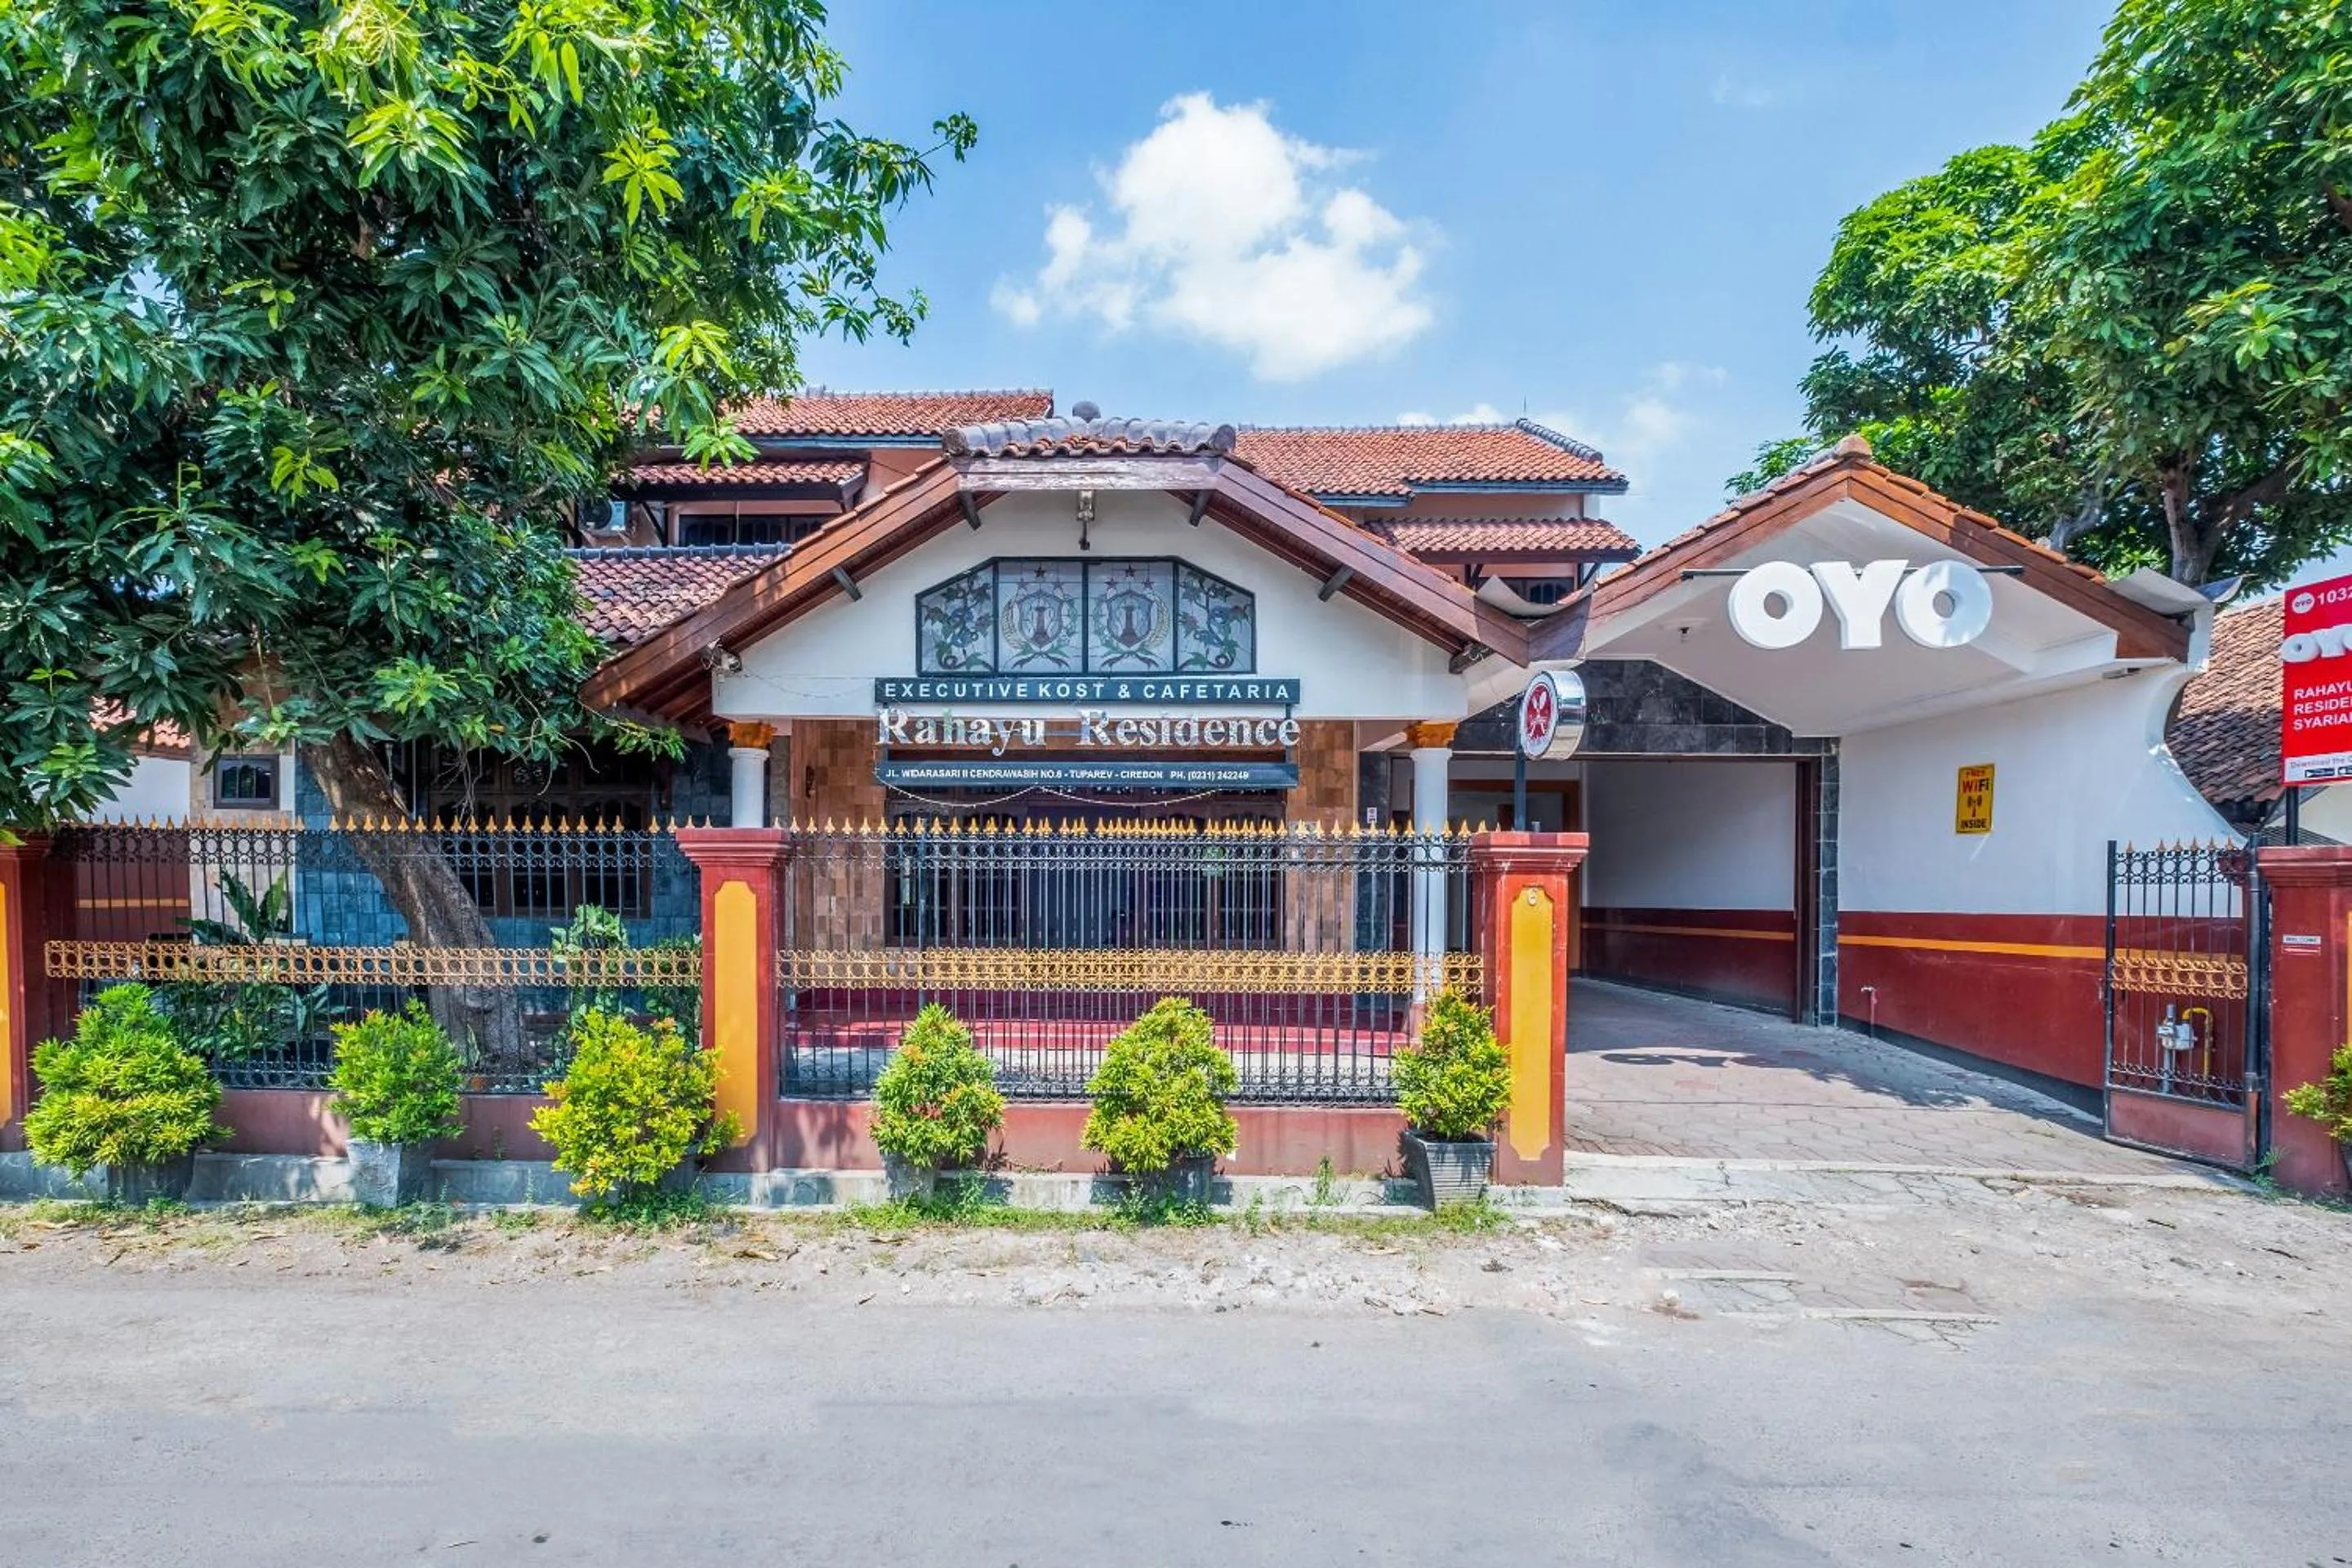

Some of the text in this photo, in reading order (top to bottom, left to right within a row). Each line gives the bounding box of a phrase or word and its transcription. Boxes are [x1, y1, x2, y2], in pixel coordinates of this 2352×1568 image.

[1728, 559, 1993, 649] OYO
[2279, 623, 2352, 663] OY
[884, 683, 1290, 699] EXECUTIVE KOST & CAFETARIA
[2293, 696, 2352, 715] RESIDE
[2293, 711, 2352, 732] SYARIA
[876, 708, 1301, 756] Rahayu Residence
[885, 768, 899, 777] JL.
[901, 768, 960, 778] WIDARASARI
[970, 768, 1038, 778] CENDRAWASIH
[1069, 769, 1112, 778] TUPAREV
[1120, 770, 1163, 778] CIREBON
[1170, 770, 1186, 779] PH.
[1961, 818, 1988, 830] INSIDE
